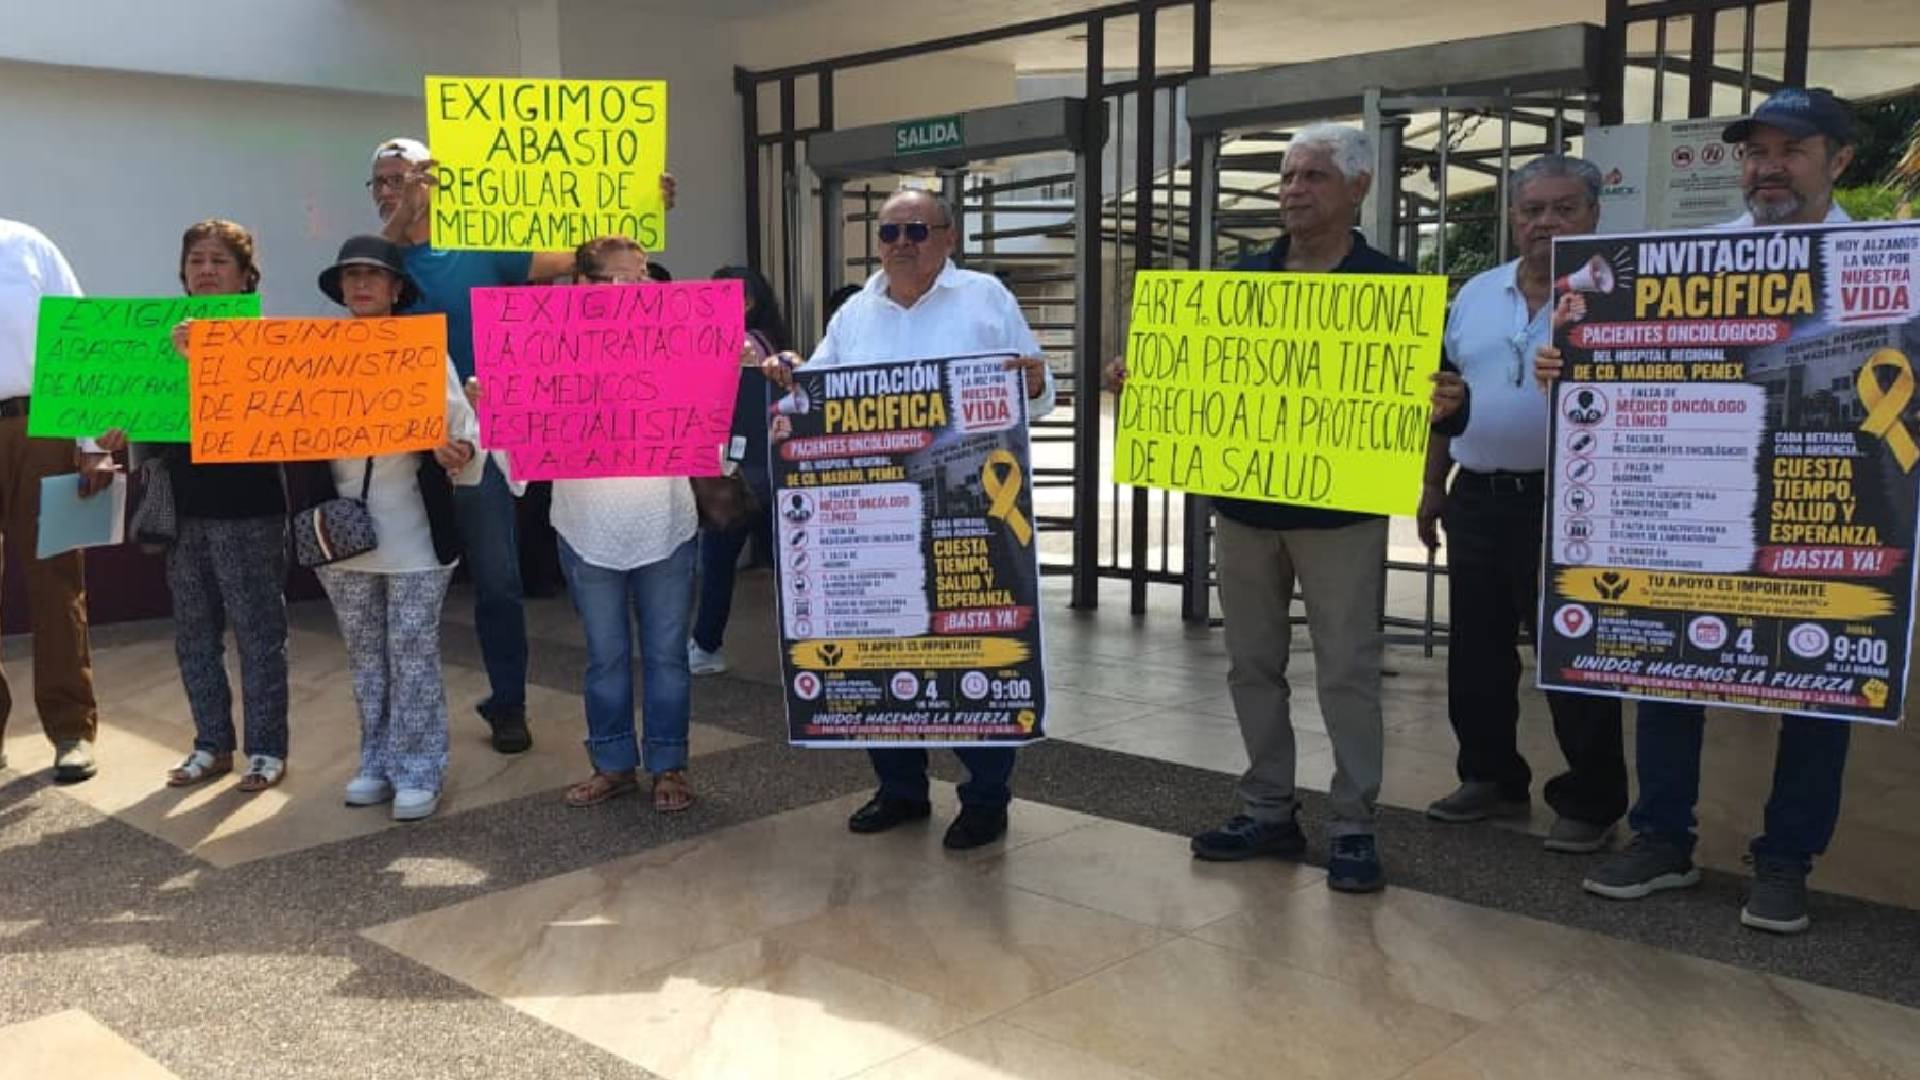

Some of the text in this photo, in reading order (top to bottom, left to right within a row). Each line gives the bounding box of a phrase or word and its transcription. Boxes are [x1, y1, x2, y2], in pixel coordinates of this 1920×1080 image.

[440, 84, 655, 123] EXIGIMOS
[486, 126, 638, 166] ABASTO
[897, 121, 958, 149] SALIDA
[438, 167, 634, 209] REGULAR DE
[437, 209, 657, 247] MEDICAMENTOS
[1638, 234, 1810, 274] INVITACIÓN
[1835, 240, 1859, 251] HOY
[1843, 253, 1910, 267] LA VOZ POR
[1841, 269, 1910, 283] NUESTRA
[1634, 271, 1814, 318] PACÍFICA
[1841, 285, 1909, 311] VIDA
[1132, 279, 1183, 325] ART
[1216, 280, 1429, 337] CONSTITUCIONAL
[201, 320, 399, 347] EXIGIMOS
[1583, 320, 1777, 344] PACIENTES ONCOLÓGICOS
[46, 338, 150, 363] ABASTO
[484, 331, 517, 367] LA
[1594, 351, 1612, 362] DEL
[1616, 349, 1666, 361] HOSPITAL
[199, 346, 437, 386] EL SUMINISTRO
[1132, 332, 1422, 395] TODA PERSONA TIENE
[1574, 364, 1590, 379] DE
[1691, 363, 1743, 379] PEMEX
[40, 373, 67, 397] DE
[530, 371, 659, 406] MEDICOS
[826, 363, 939, 399] INVITACIÓN
[200, 383, 428, 422] DE REACTIVOS
[962, 387, 1008, 399] NUESTRA
[825, 393, 947, 433] PACÍFICA
[962, 400, 1010, 423] VIDA
[1616, 399, 1746, 413] MÉDICO ONCÓLOGO
[490, 406, 731, 447] ESPECIALISTAS
[1123, 385, 1431, 455] DERECHO A LA PROTECCION
[1616, 413, 1667, 427] CLÍNICO
[201, 416, 443, 456] DE LABORATORIO
[1775, 432, 1802, 443] CADA
[791, 438, 847, 458] PACIENTES
[1775, 444, 1802, 455] CADA
[513, 446, 721, 476] VACANTES
[1130, 440, 1332, 504] DE LA SALUD.
[1773, 457, 1853, 479] CUESTA
[1773, 480, 1856, 501] TIEMPO,
[1771, 501, 1855, 522] SALUD Y
[1770, 524, 1882, 545] ESPERANZA.
[933, 538, 988, 555] CUESTA
[1773, 549, 1884, 571] ¡BASTA YA!
[936, 571, 994, 590] SALUD Y
[1648, 575, 1826, 596] TU APOYO ES IMPORTANTE
[944, 610, 1018, 631] ¡BASTA YA!
[1736, 629, 1754, 652] 4
[1834, 636, 1888, 665] 9:00
[1720, 653, 1768, 666] DE MAYO
[1825, 662, 1838, 671] DE
[1572, 655, 1643, 673] UNIDOS
[1646, 662, 1737, 683] HACEMOS
[1741, 670, 1767, 684] LA
[1771, 671, 1854, 692] FUERZA
[925, 680, 937, 700] 4
[991, 680, 1031, 699] 9:00
[812, 711, 1011, 724] UNIDOS HACEMOS LA FUERZA
